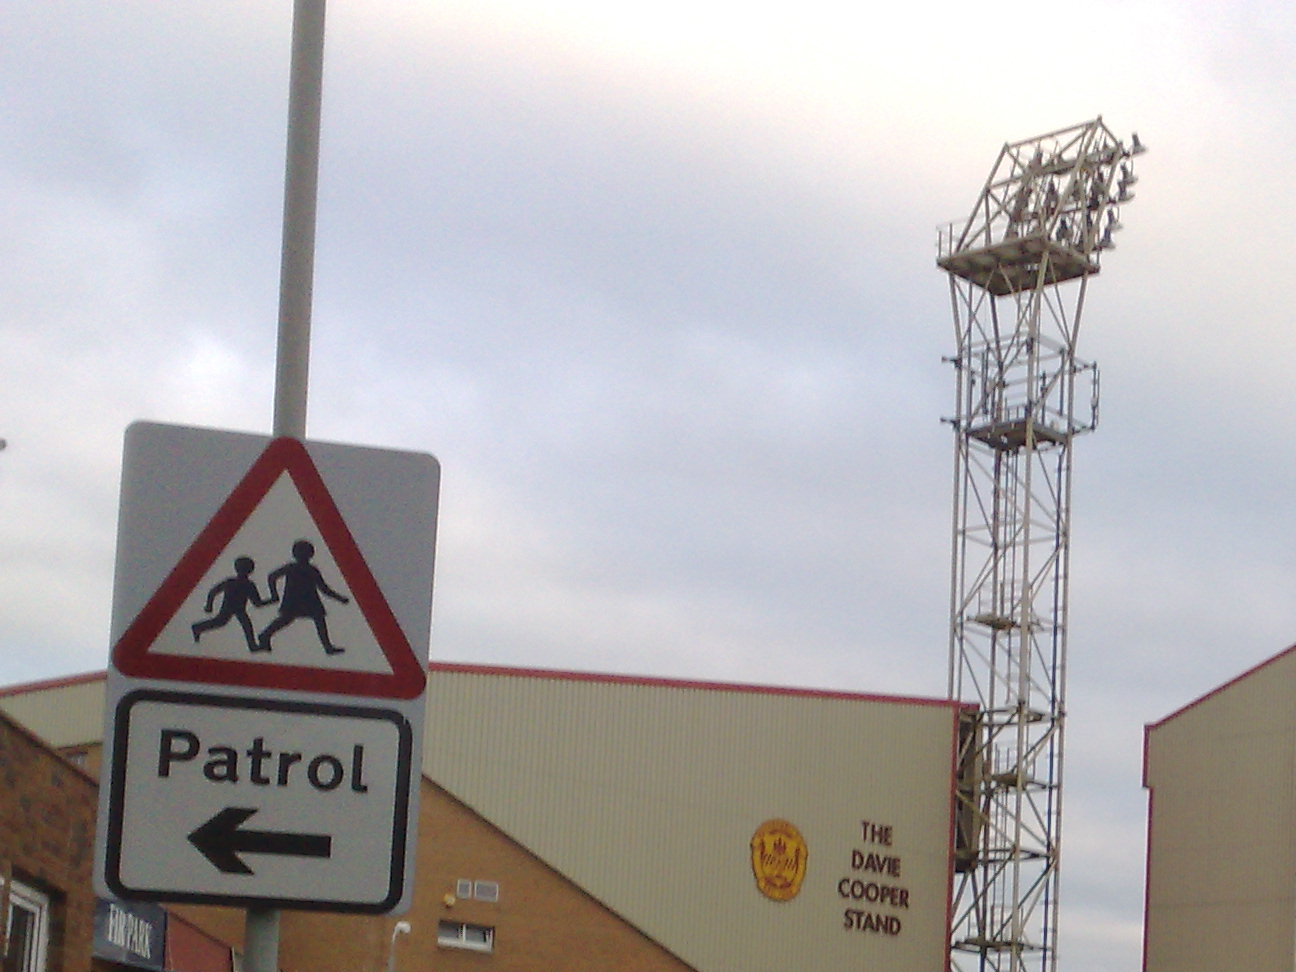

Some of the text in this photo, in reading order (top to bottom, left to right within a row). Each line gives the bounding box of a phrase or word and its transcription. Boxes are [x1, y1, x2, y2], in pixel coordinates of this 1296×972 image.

[158, 728, 368, 794] Patrol
[862, 820, 893, 847] THE
[851, 848, 902, 878] DAVIE
[838, 877, 910, 911] COOPER
[844, 907, 902, 936] STAND
